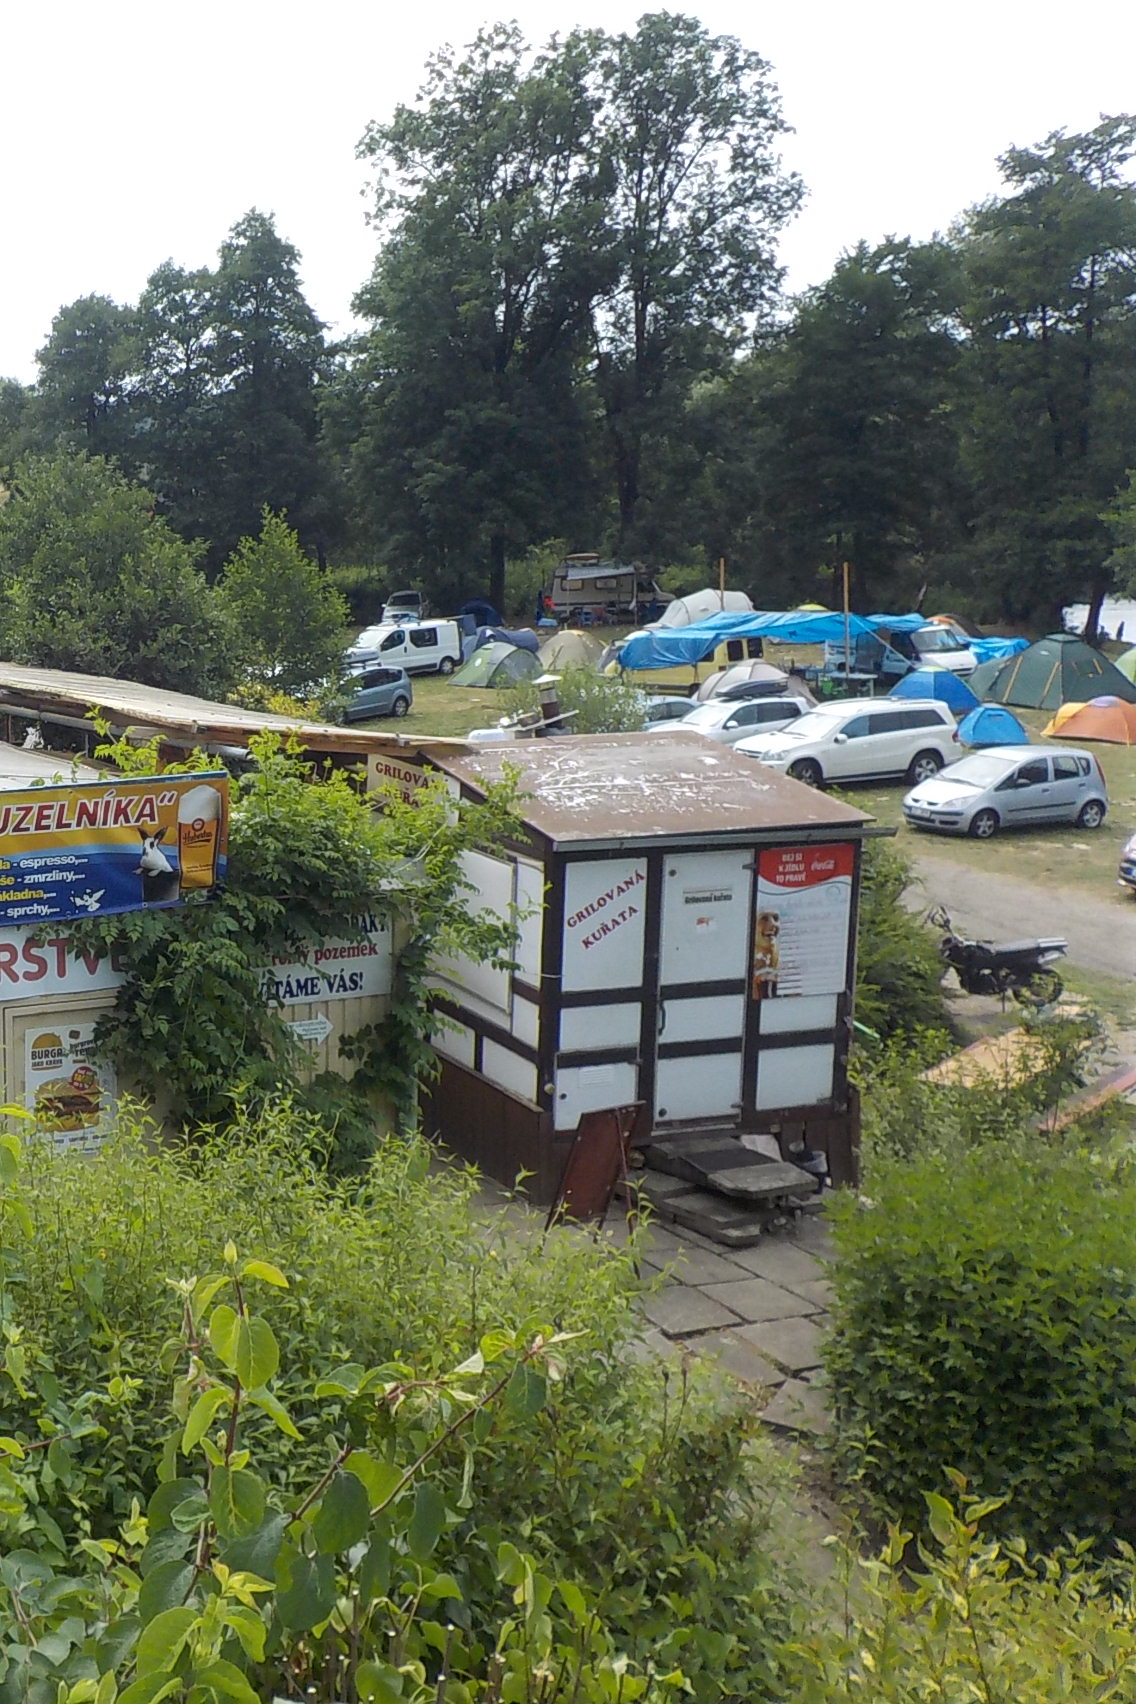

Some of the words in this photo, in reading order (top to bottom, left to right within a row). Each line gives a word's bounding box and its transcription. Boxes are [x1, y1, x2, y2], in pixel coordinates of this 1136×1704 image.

[566, 869, 645, 928] GRILOVANÁ
[581, 905, 639, 949] KUŘATA
[314, 943, 379, 965] pozemek
[325, 968, 364, 993] VÁS!
